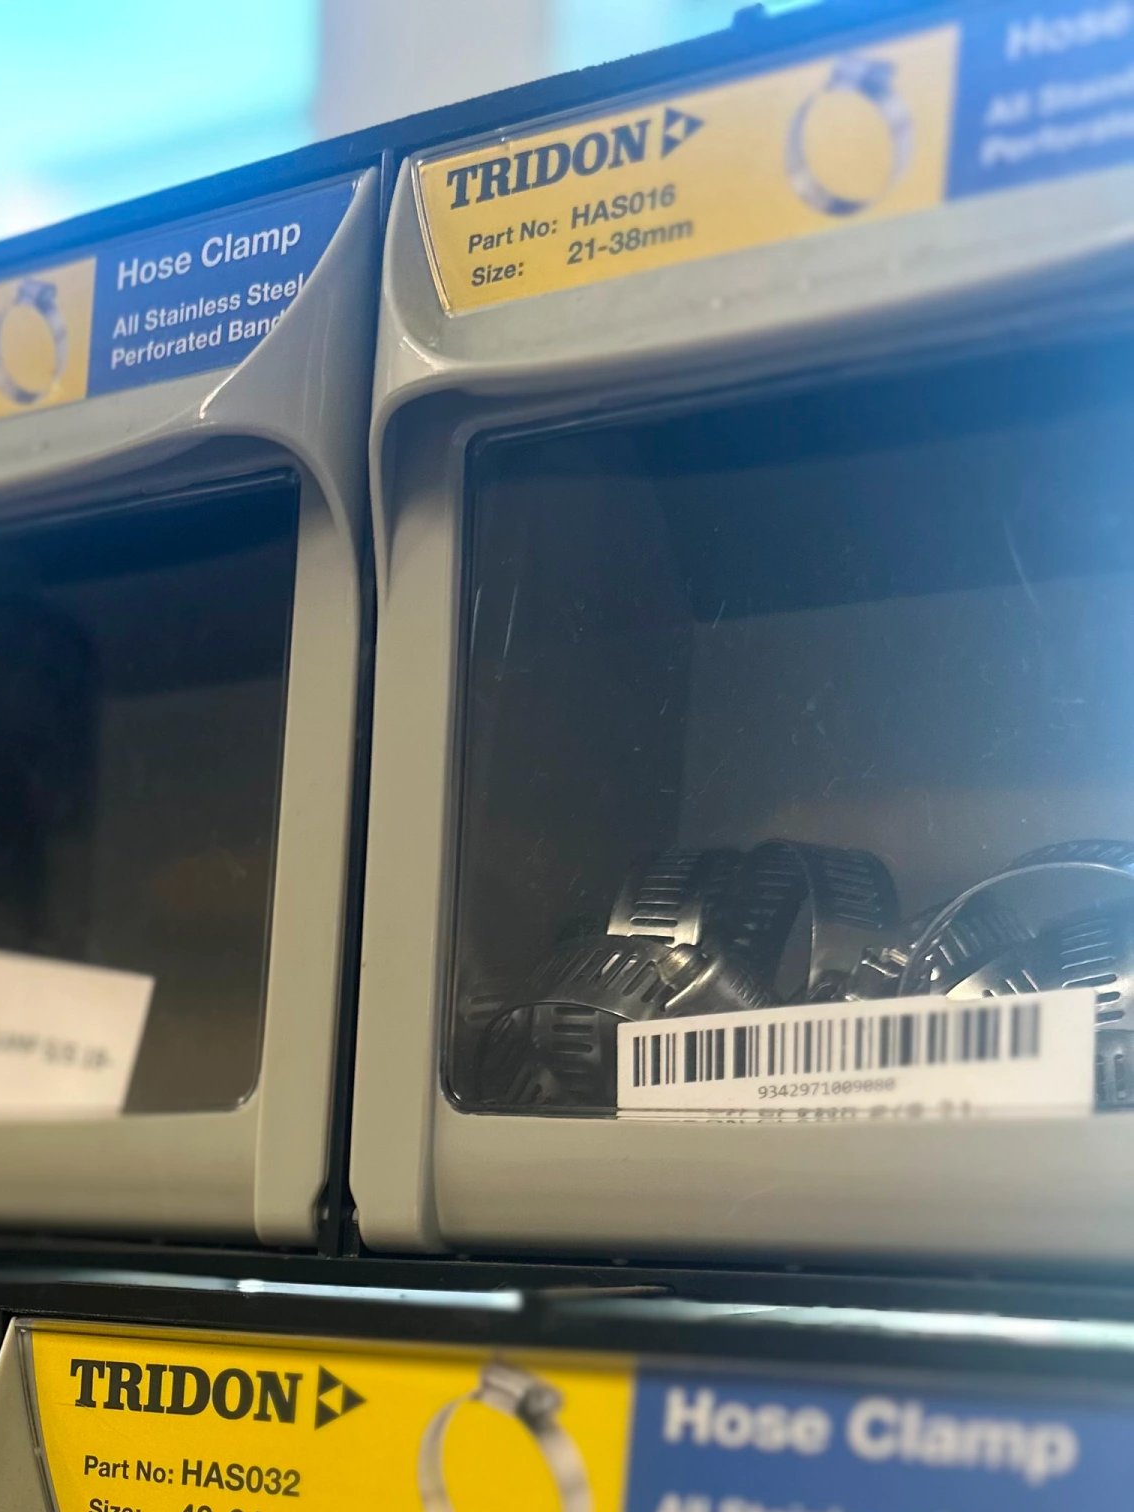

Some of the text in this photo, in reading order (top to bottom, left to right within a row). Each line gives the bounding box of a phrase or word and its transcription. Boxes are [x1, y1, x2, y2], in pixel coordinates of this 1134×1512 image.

[446, 119, 652, 210] TRIDON
[468, 184, 677, 254] Part No: HAS016
[116, 222, 301, 291] Hose Clamp
[471, 220, 694, 287] Size: 21-38mm
[112, 272, 304, 339] All Stainless Steel
[110, 324, 222, 370] Perforated
[70, 1358, 303, 1424] TRIDON
[664, 1387, 1078, 1487] Hose Clamp
[83, 1455, 301, 1498] Part No: HAS032
